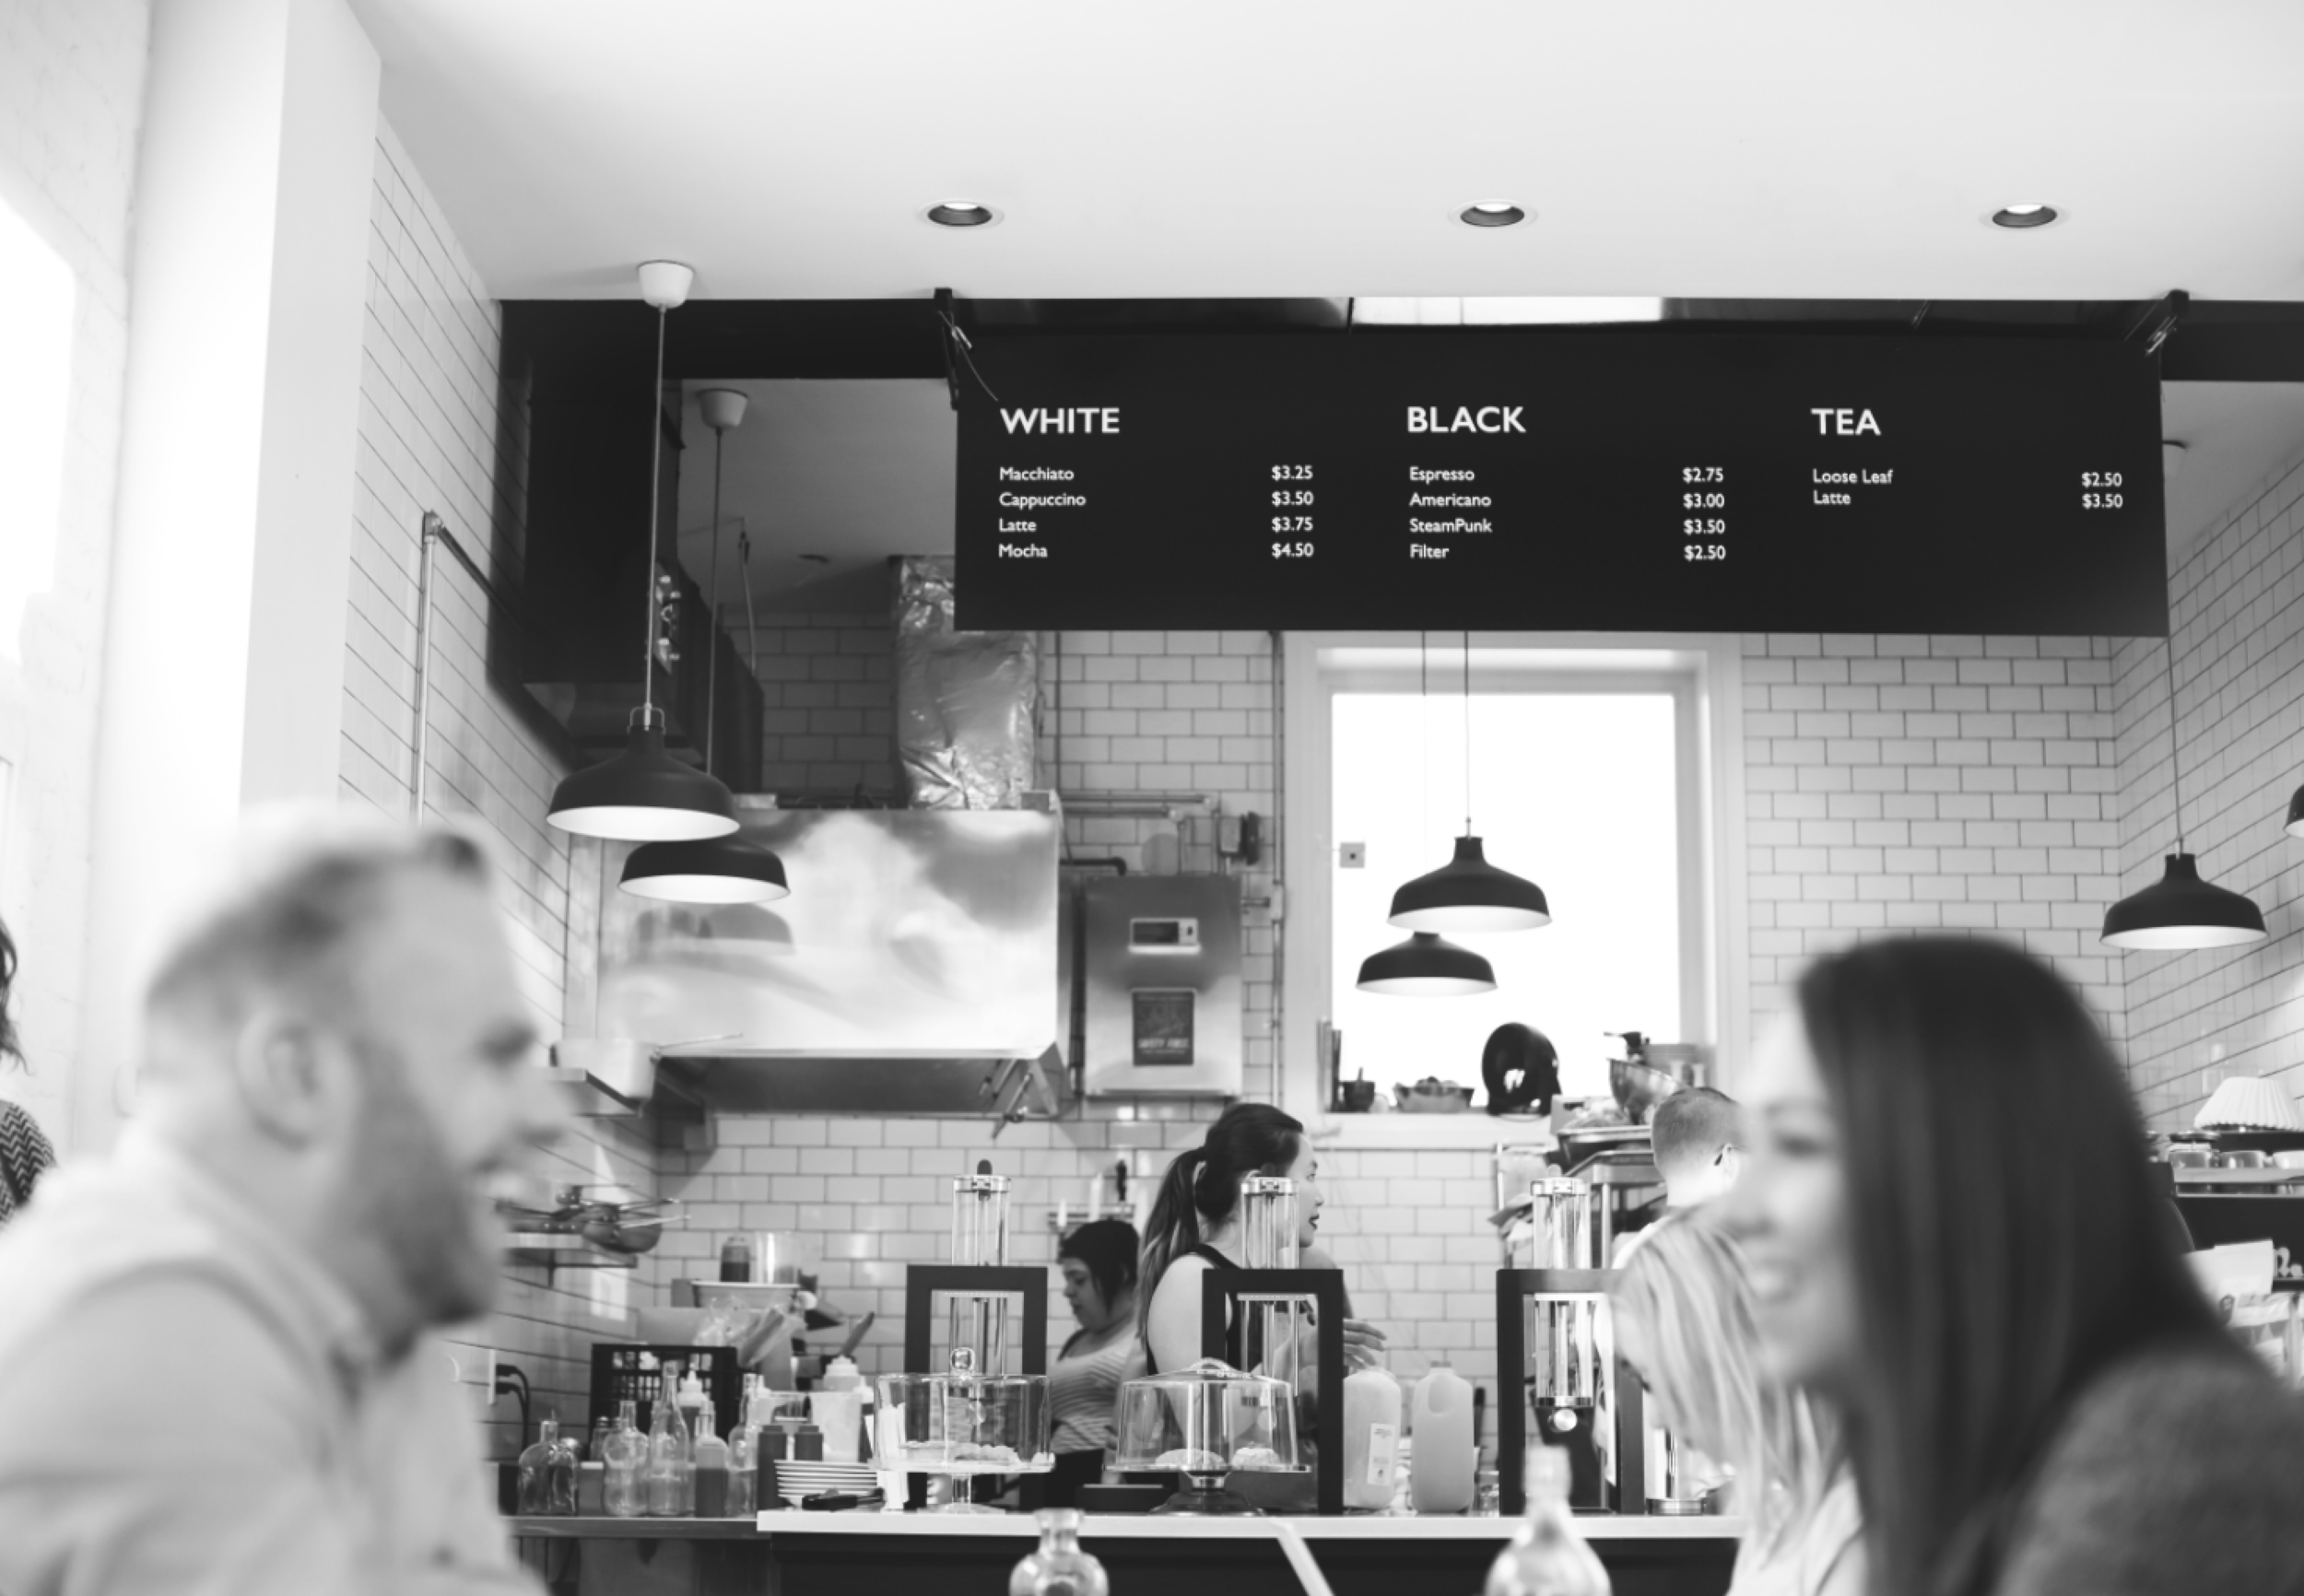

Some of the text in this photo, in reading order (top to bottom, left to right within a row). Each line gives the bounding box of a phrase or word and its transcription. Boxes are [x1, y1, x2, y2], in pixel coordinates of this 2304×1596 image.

[1000, 407, 1120, 434] WHITE
[1407, 406, 1526, 433] BLACK
[1811, 408, 1881, 435] TEA
[1000, 465, 1313, 481] Macchiato $3.25
[1410, 466, 1723, 485] Espresso $2.75
[1813, 469, 2122, 487] Loose Leaf $2.50
[999, 491, 1313, 510] Cappuccino $3.50
[1409, 492, 1724, 510] Americano $3.00
[1814, 490, 2122, 509] Latte $3.50
[999, 517, 1313, 533] Latte $3.75
[1410, 518, 1725, 534] SteamPunk $3.50
[999, 543, 1313, 558] Mocha $4.50
[1410, 544, 1726, 561] Filter $2.50
